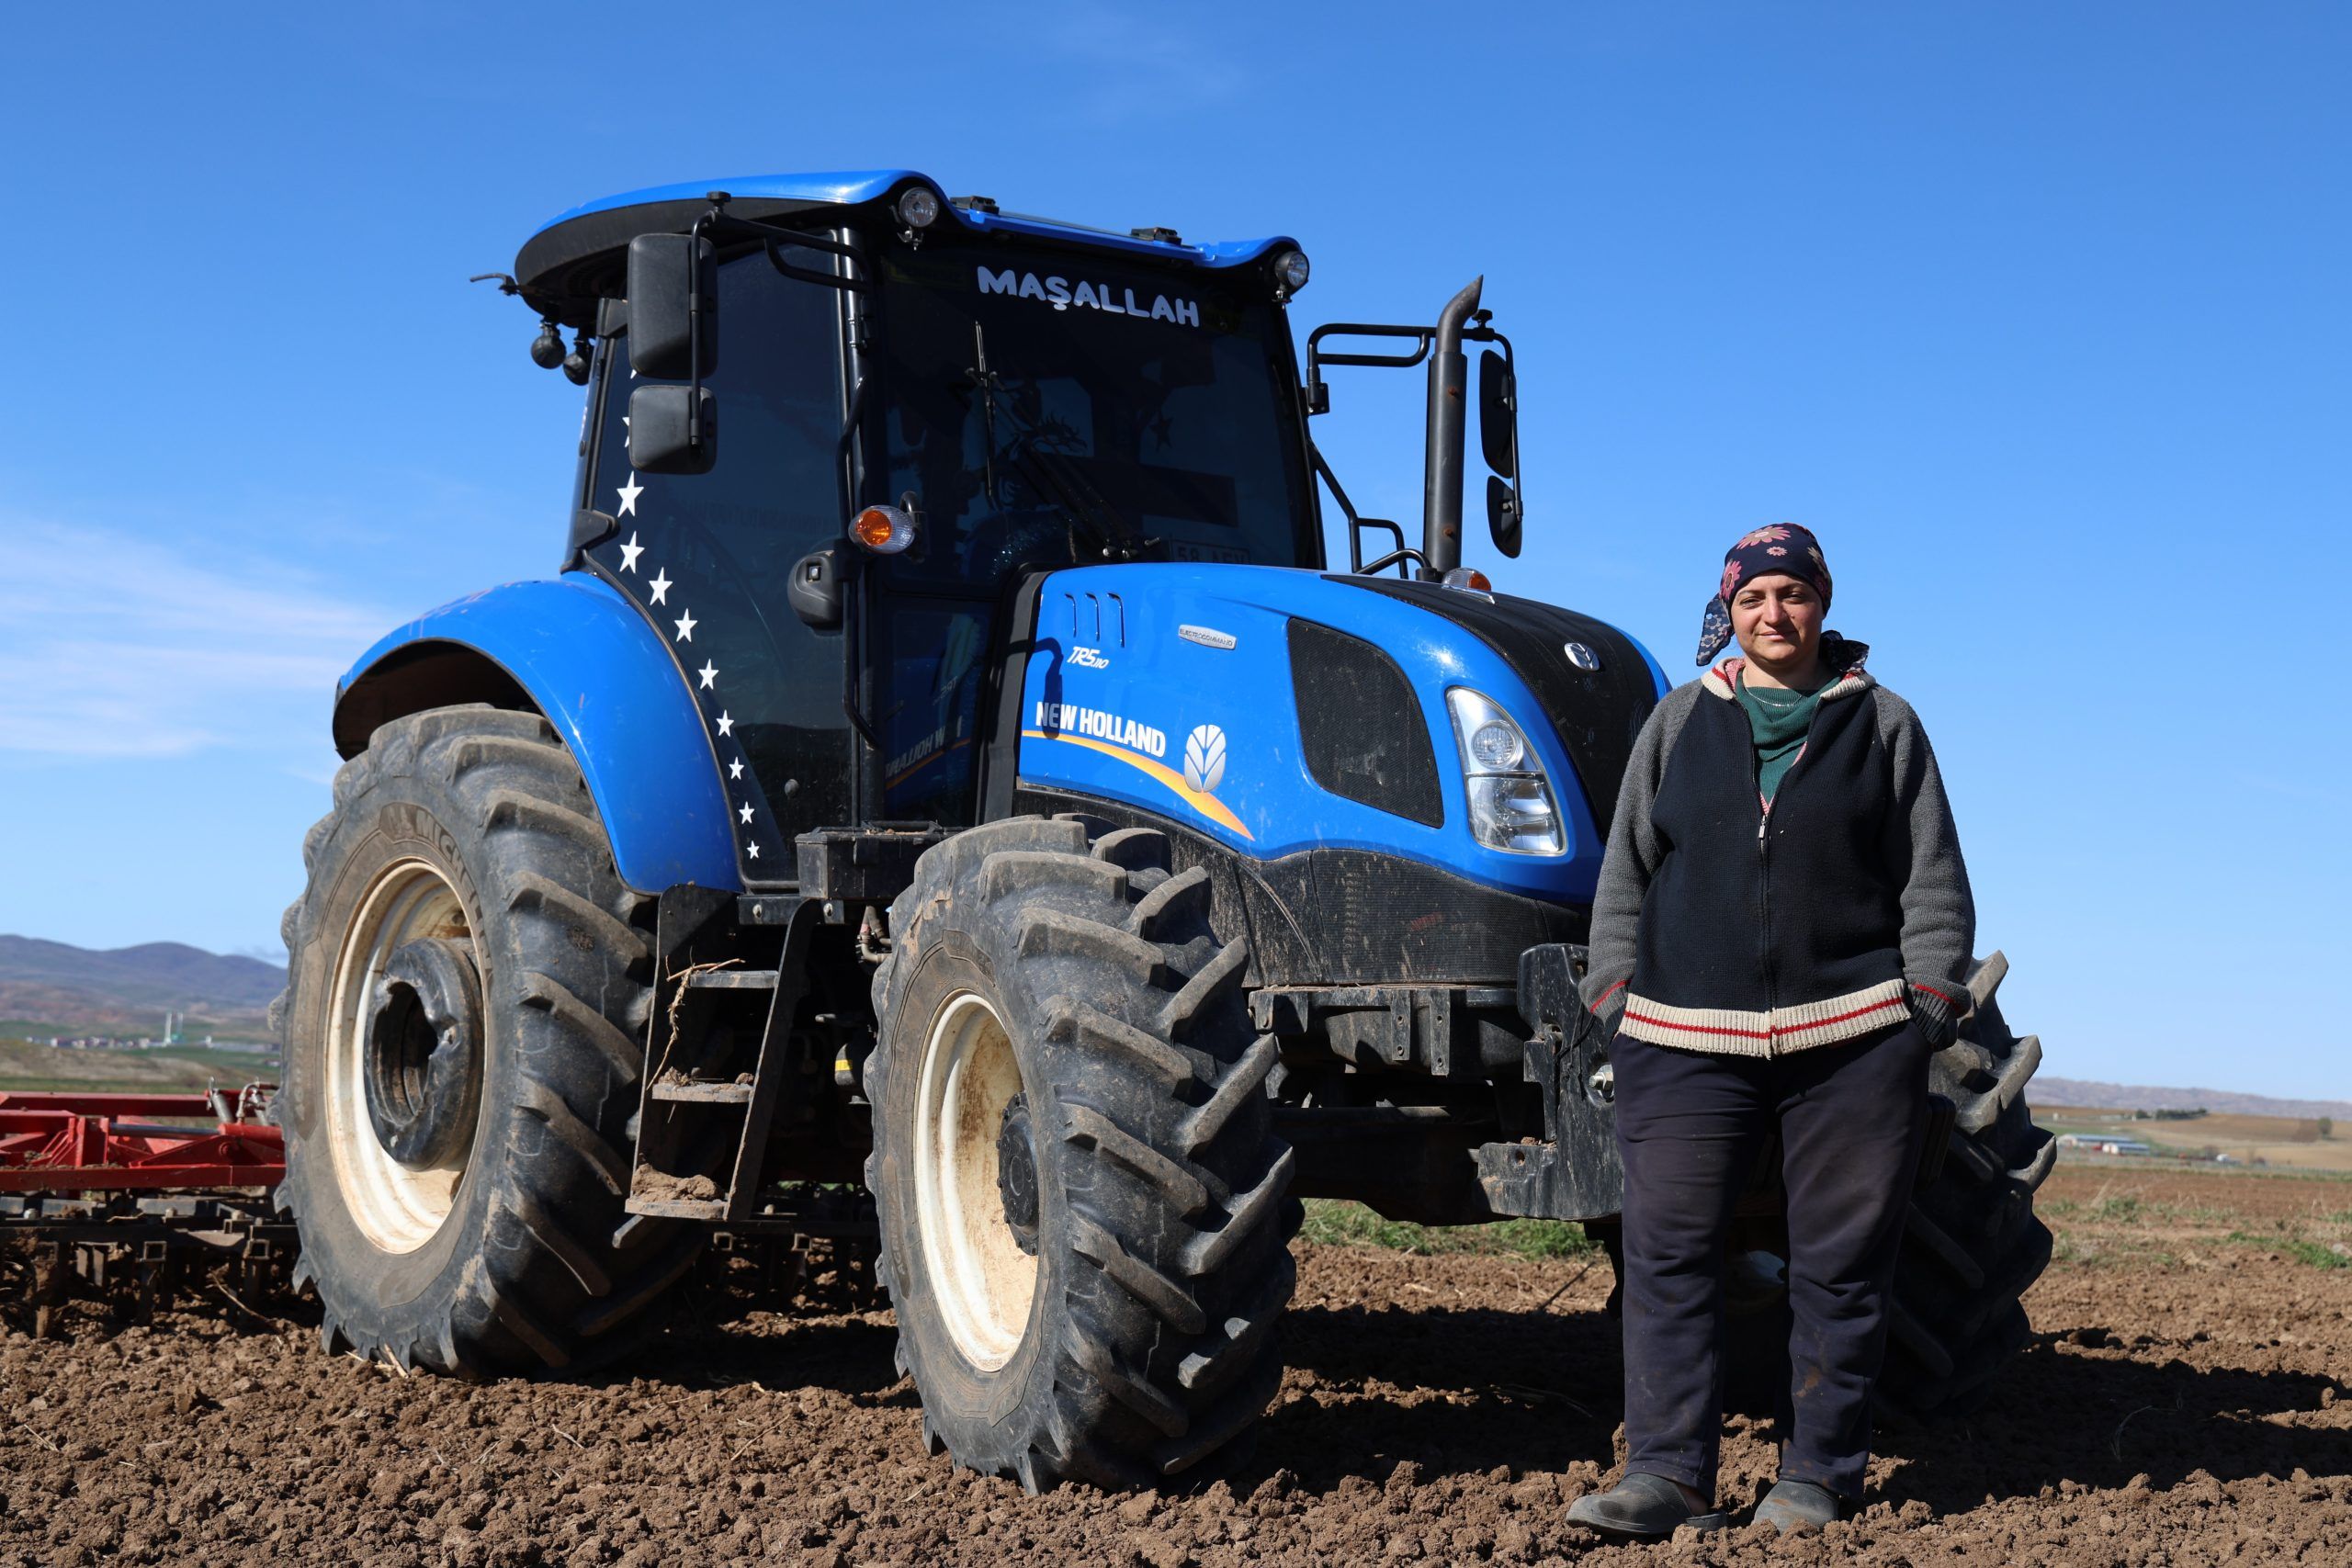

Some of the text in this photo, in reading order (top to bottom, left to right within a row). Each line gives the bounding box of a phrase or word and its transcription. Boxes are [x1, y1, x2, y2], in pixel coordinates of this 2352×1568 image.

[977, 265, 1200, 328] MAŞALLAH
[1035, 701, 1166, 758] NEW HOLLAND
